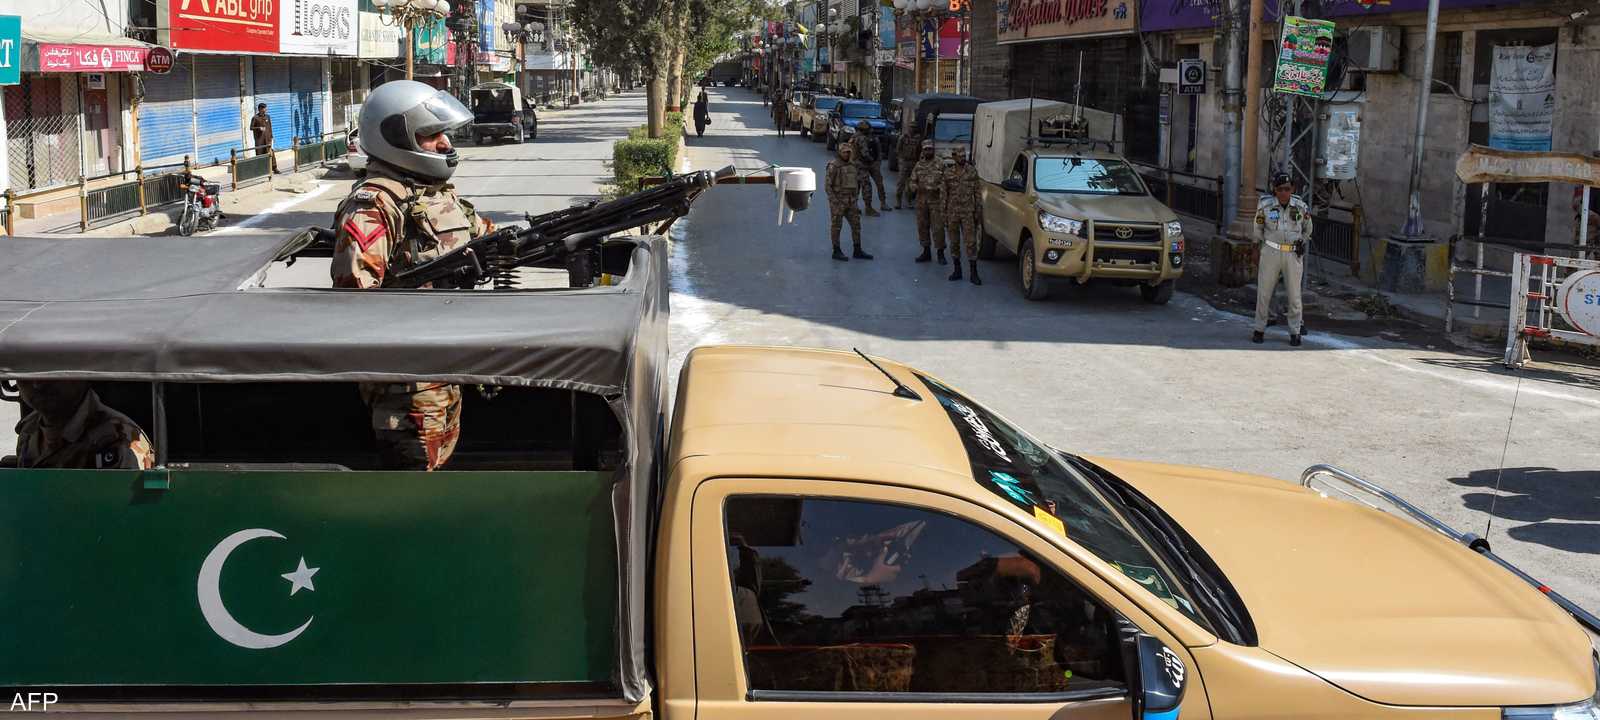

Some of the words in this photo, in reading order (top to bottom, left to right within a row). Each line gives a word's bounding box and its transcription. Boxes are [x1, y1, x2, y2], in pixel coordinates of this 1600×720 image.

[0, 39, 14, 67] T
[115, 50, 140, 63] FINCA
[150, 55, 170, 65] ATM
